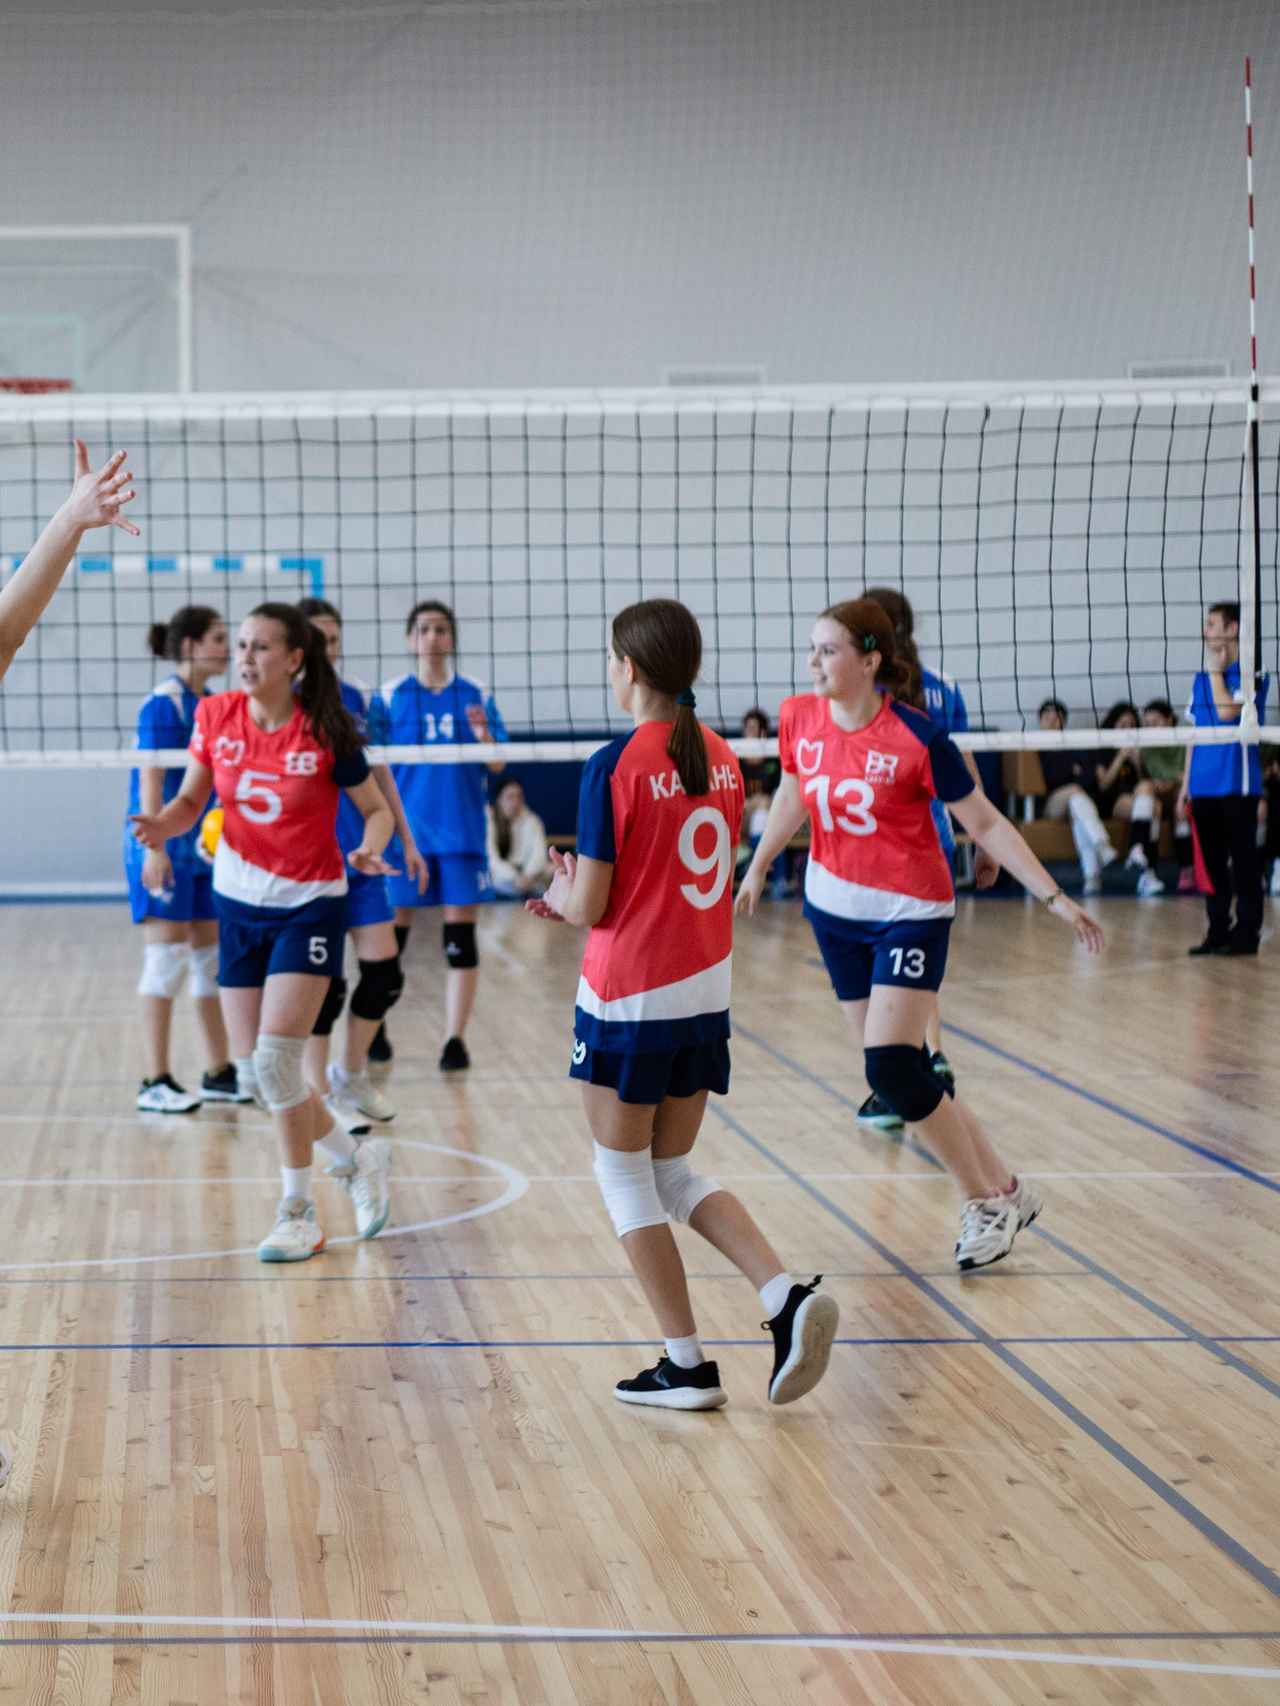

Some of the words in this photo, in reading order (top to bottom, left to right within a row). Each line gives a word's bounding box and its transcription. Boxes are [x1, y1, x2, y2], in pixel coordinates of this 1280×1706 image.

[424, 713, 455, 740] 14
[235, 768, 283, 824] 5
[804, 774, 877, 836] 13
[678, 805, 732, 910] 9
[309, 935, 329, 966] 5
[889, 947, 926, 979] 13
